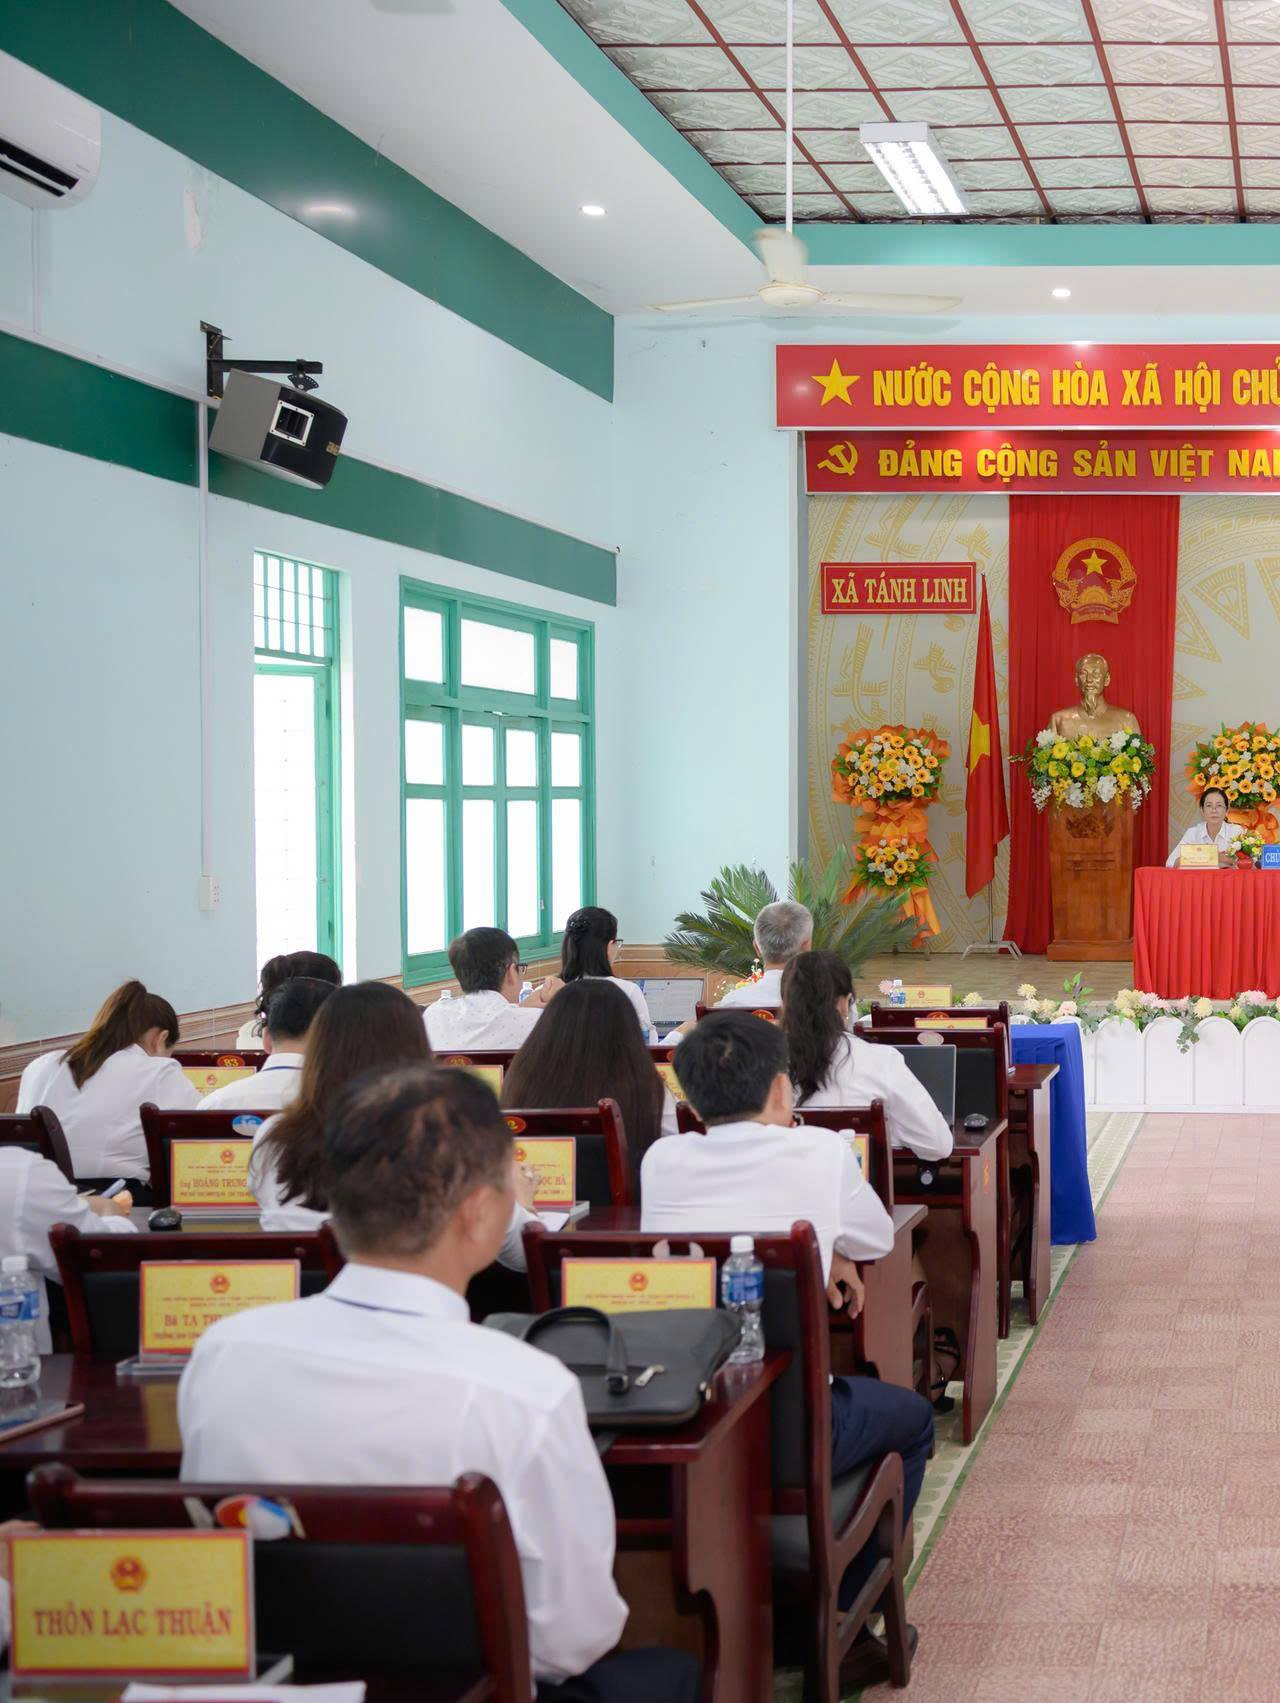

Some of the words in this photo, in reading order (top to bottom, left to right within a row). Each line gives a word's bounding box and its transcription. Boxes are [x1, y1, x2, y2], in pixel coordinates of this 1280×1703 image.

[873, 361, 952, 407] NƯỚC
[964, 361, 1041, 413] CỘNG
[1052, 360, 1110, 407] HÒA
[1121, 362, 1163, 406] XÃ
[1175, 361, 1221, 413] HỘI
[878, 440, 963, 477] ĐẢNG
[977, 443, 1058, 482] CỘNG
[1072, 440, 1137, 477] SẢN
[1150, 443, 1214, 482] VIỆT
[831, 572, 859, 604] XÃ
[864, 571, 917, 604] TÁNH
[922, 577, 968, 604] LINH
[34, 1602, 95, 1636] THÔN
[154, 1602, 232, 1641] THUẬN
